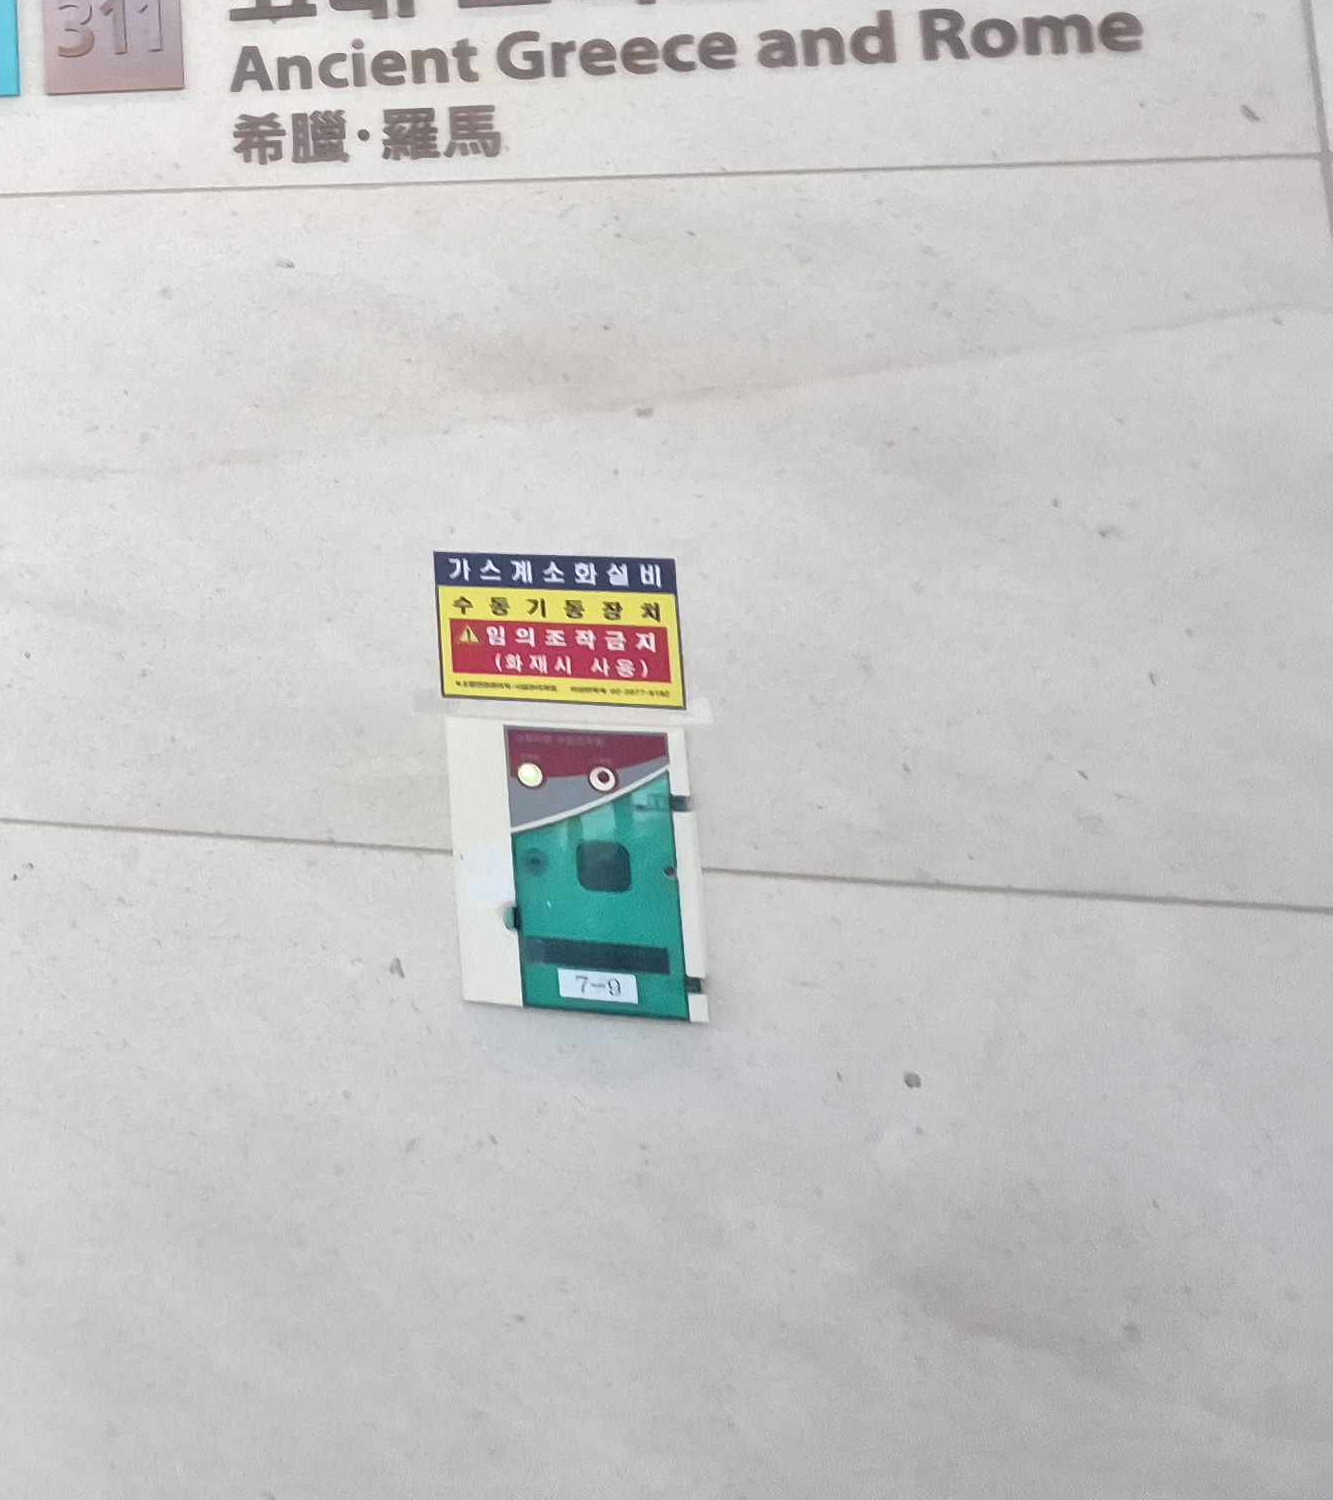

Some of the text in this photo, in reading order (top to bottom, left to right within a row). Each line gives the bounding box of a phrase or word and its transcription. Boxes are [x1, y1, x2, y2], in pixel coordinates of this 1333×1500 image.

[229, 7, 1144, 93] Ancient Greece and Rome
[232, 104, 502, 166] 希臘·羅馬
[575, 974, 622, 996] 7-9
